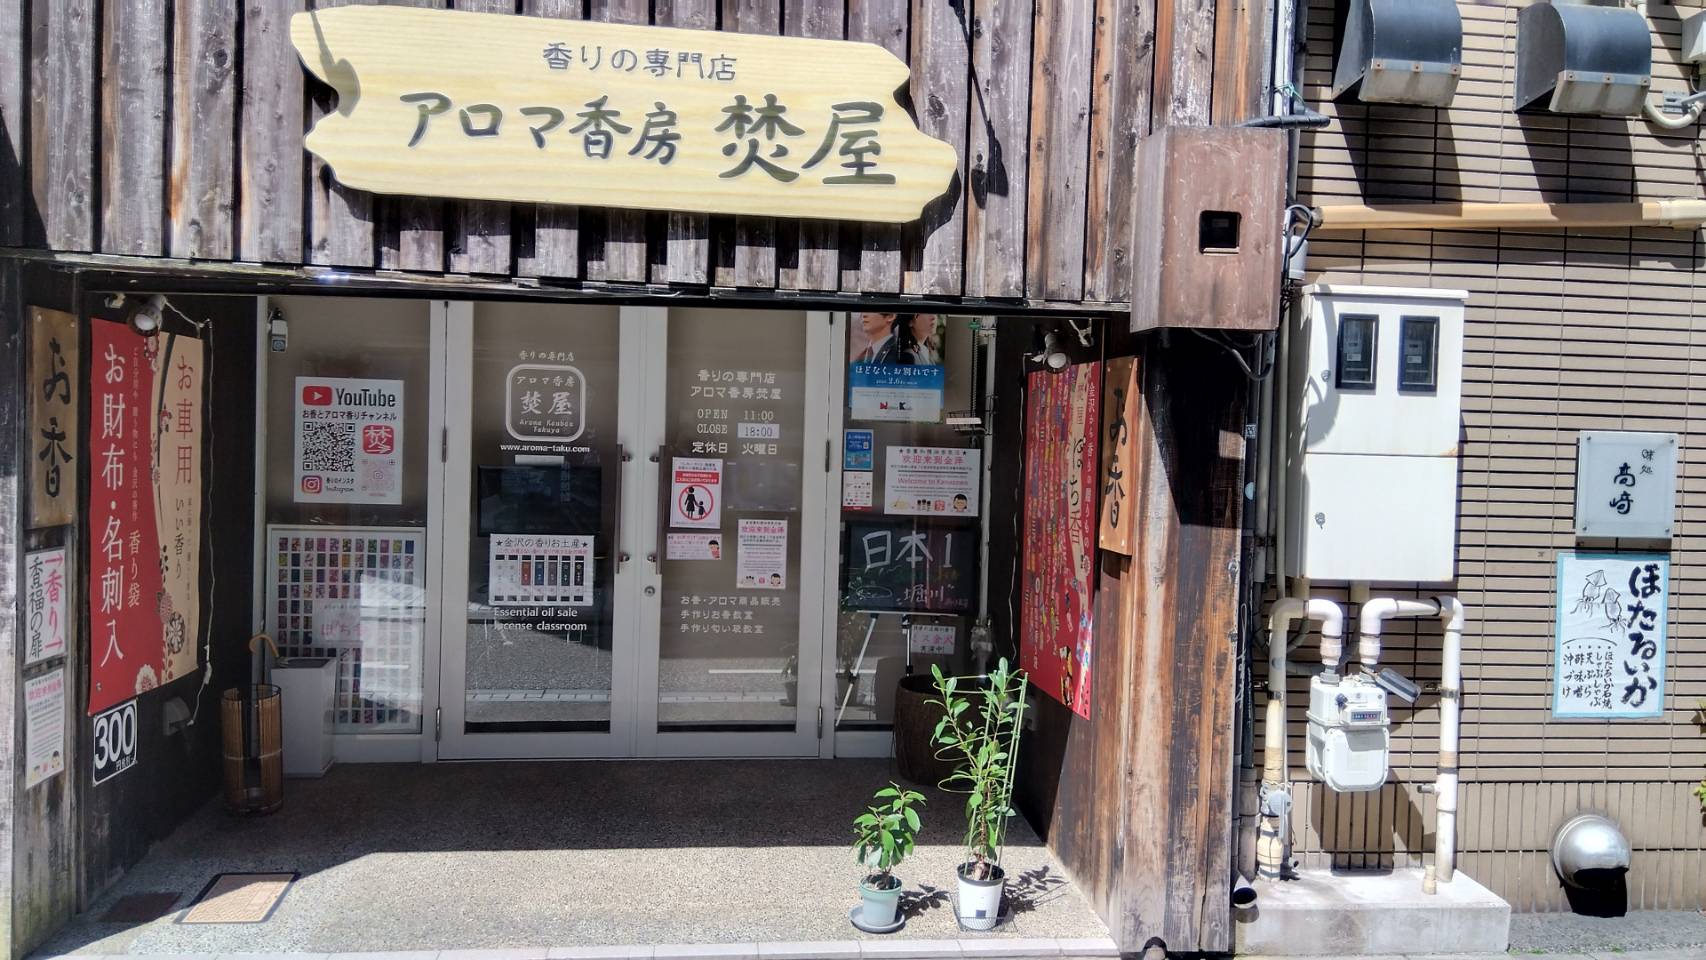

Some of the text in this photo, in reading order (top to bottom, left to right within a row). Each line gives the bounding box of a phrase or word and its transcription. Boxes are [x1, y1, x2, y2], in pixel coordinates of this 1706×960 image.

[542, 42, 738, 82] 香りの専門店
[400, 93, 897, 186] アロマ香房 焚屋
[519, 350, 575, 362] 香りの専門店
[697, 369, 776, 384] 香りの専門店
[855, 365, 940, 377] ほどなく、お別れです
[516, 375, 576, 387] アロマ香房
[336, 388, 396, 408] YouTube
[690, 386, 782, 400] アロマ香房焚屋
[520, 390, 573, 416] 焚屋
[38, 338, 73, 498] お香
[175, 355, 194, 486] お車用
[302, 409, 398, 421] お香とアロマ香りチャンネル
[697, 409, 774, 421] OPEN 11:00
[519, 419, 542, 427] Aroma
[697, 423, 773, 437] CLOSE 18:00
[500, 443, 590, 453] www.aroma-taku.com
[692, 441, 777, 455] 定休日 火曜日
[1105, 386, 1128, 530] お香
[1640, 448, 1655, 475] 味処
[101, 343, 126, 668] お財布・名刺入
[504, 538, 580, 548] 金沢の香りお土産
[127, 530, 141, 608] 香り袋
[44, 571, 64, 639] 香り
[494, 607, 578, 617] Essential oil sale
[680, 610, 754, 620] 手作りお香教室
[536, 621, 588, 631] classroom
[1620, 563, 1661, 708] ほたるいか
[95, 706, 135, 769] 300
